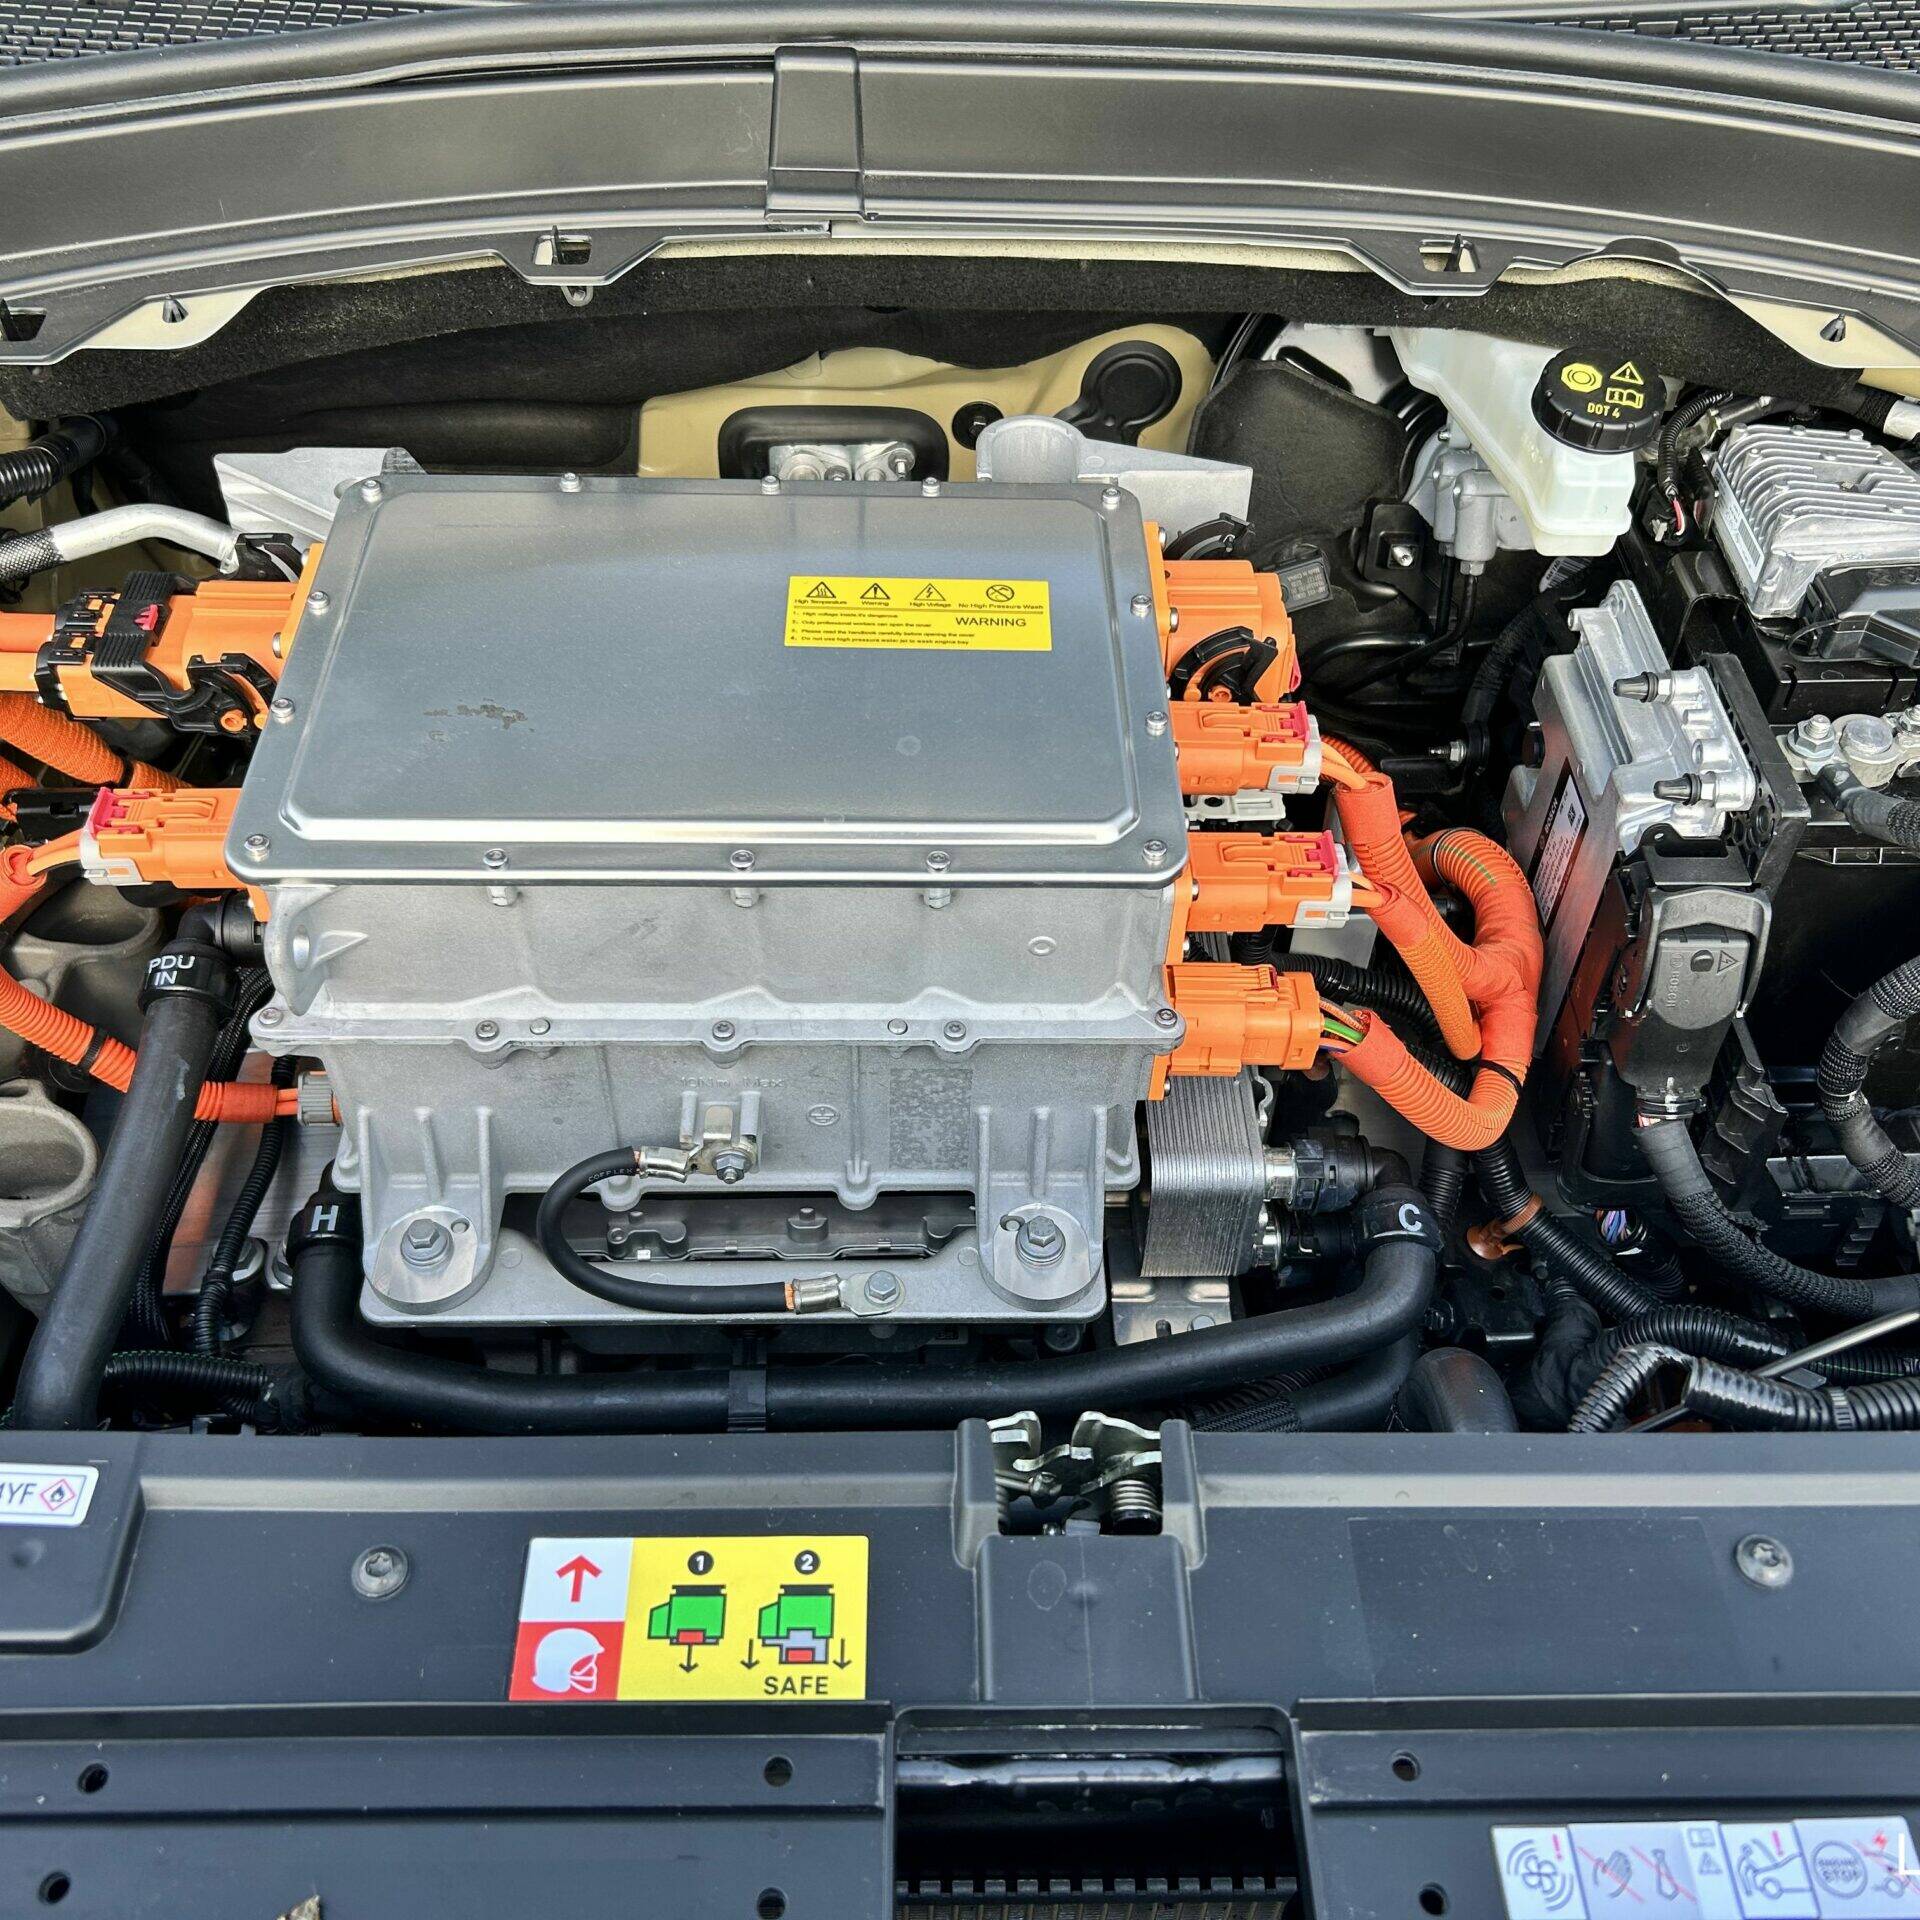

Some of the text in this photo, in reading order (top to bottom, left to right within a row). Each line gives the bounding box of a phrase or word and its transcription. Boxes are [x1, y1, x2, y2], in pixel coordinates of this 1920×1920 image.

[1587, 402, 1621, 419] DOT 4
[955, 616, 1027, 627] WARNING
[1544, 797, 1559, 834] BOSCH
[148, 954, 196, 974] PDU
[153, 970, 178, 986] IN
[311, 1205, 339, 1232] H
[1398, 1203, 1423, 1232] C
[695, 1553, 814, 1571] 1 2
[763, 1675, 829, 1696] SAFE
